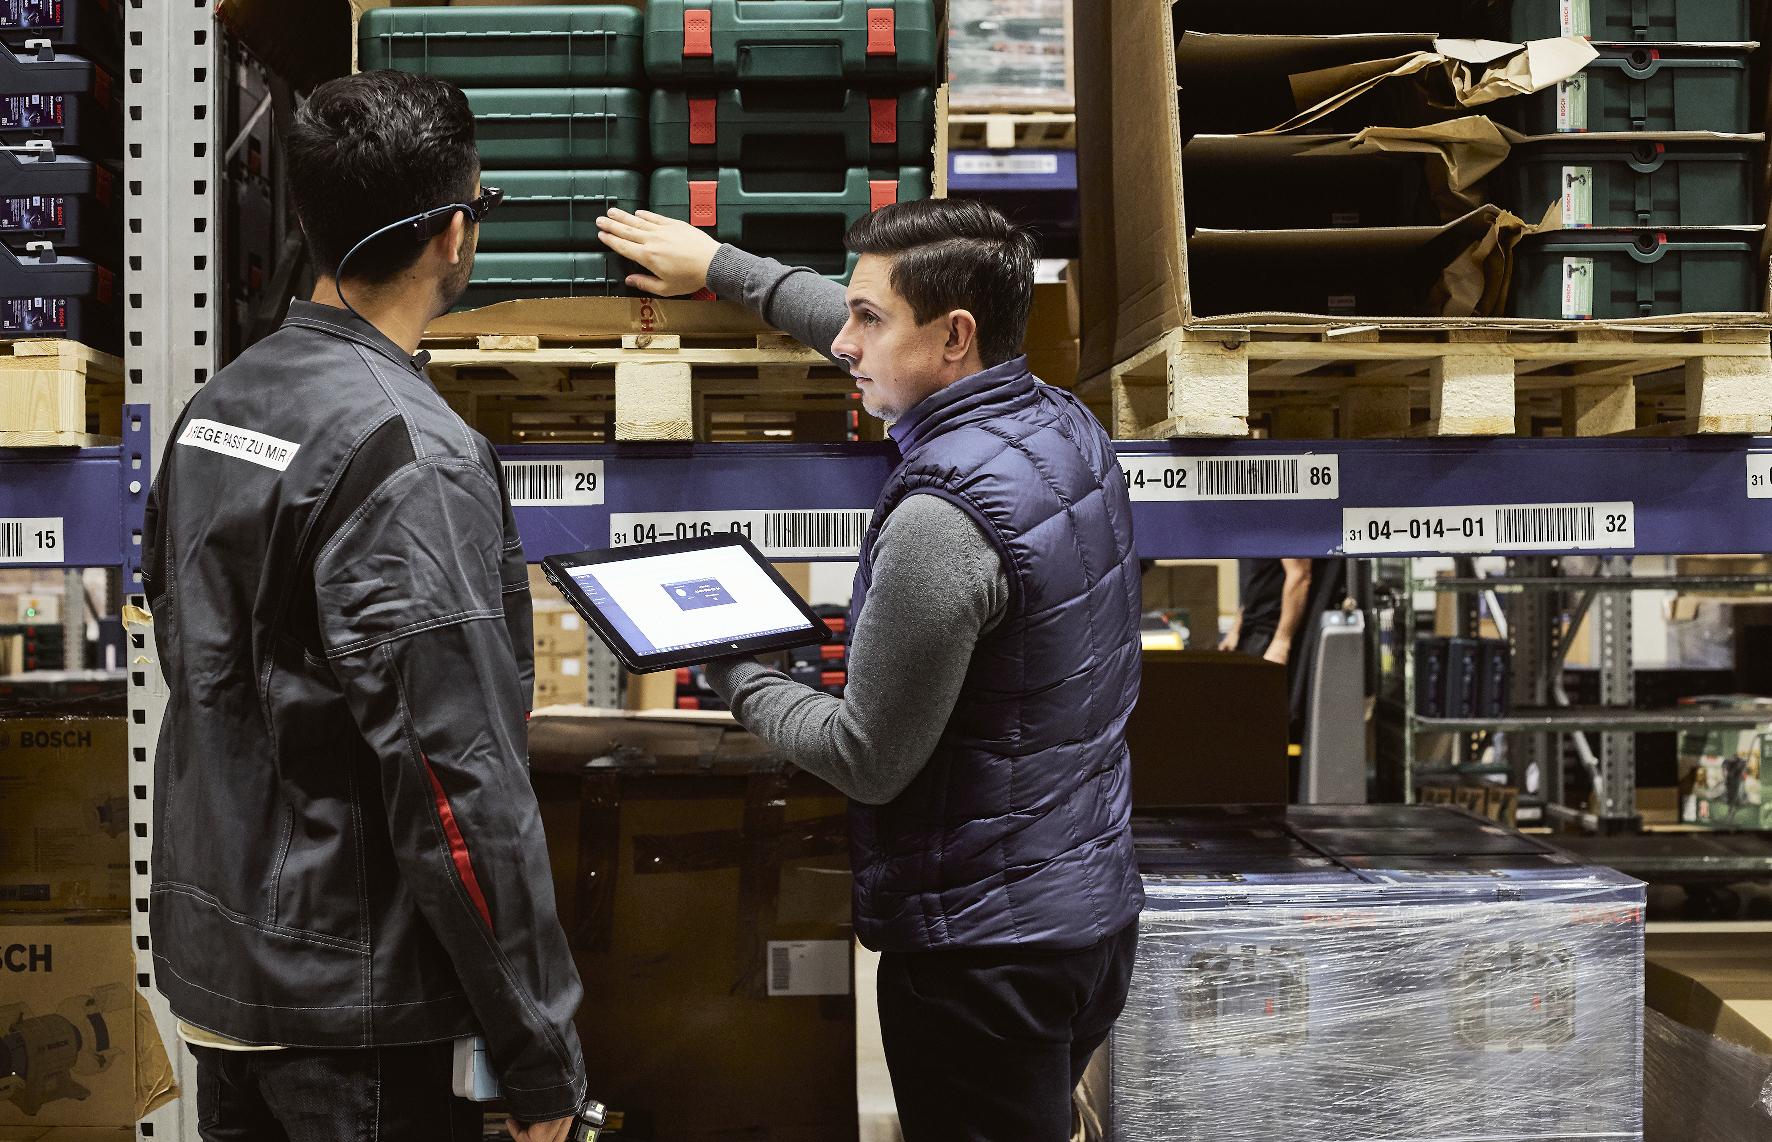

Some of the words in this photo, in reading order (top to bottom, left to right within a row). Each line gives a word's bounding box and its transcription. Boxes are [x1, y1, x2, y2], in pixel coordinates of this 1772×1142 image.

[223, 432, 248, 450] PASST
[246, 439, 264, 455] ZU
[265, 444, 288, 463] MIR
[575, 472, 597, 492] 29
[1310, 466, 1332, 486] 86
[1751, 474, 1764, 486] 31
[1350, 530, 1363, 541] 31
[1368, 517, 1485, 541] 04-014-01
[1605, 514, 1627, 533] 32
[34, 530, 56, 549] 15
[614, 532, 627, 544] 31
[20, 730, 92, 748] BOSCH
[1570, 906, 1640, 924] BOSCH
[0, 944, 52, 972] CH
